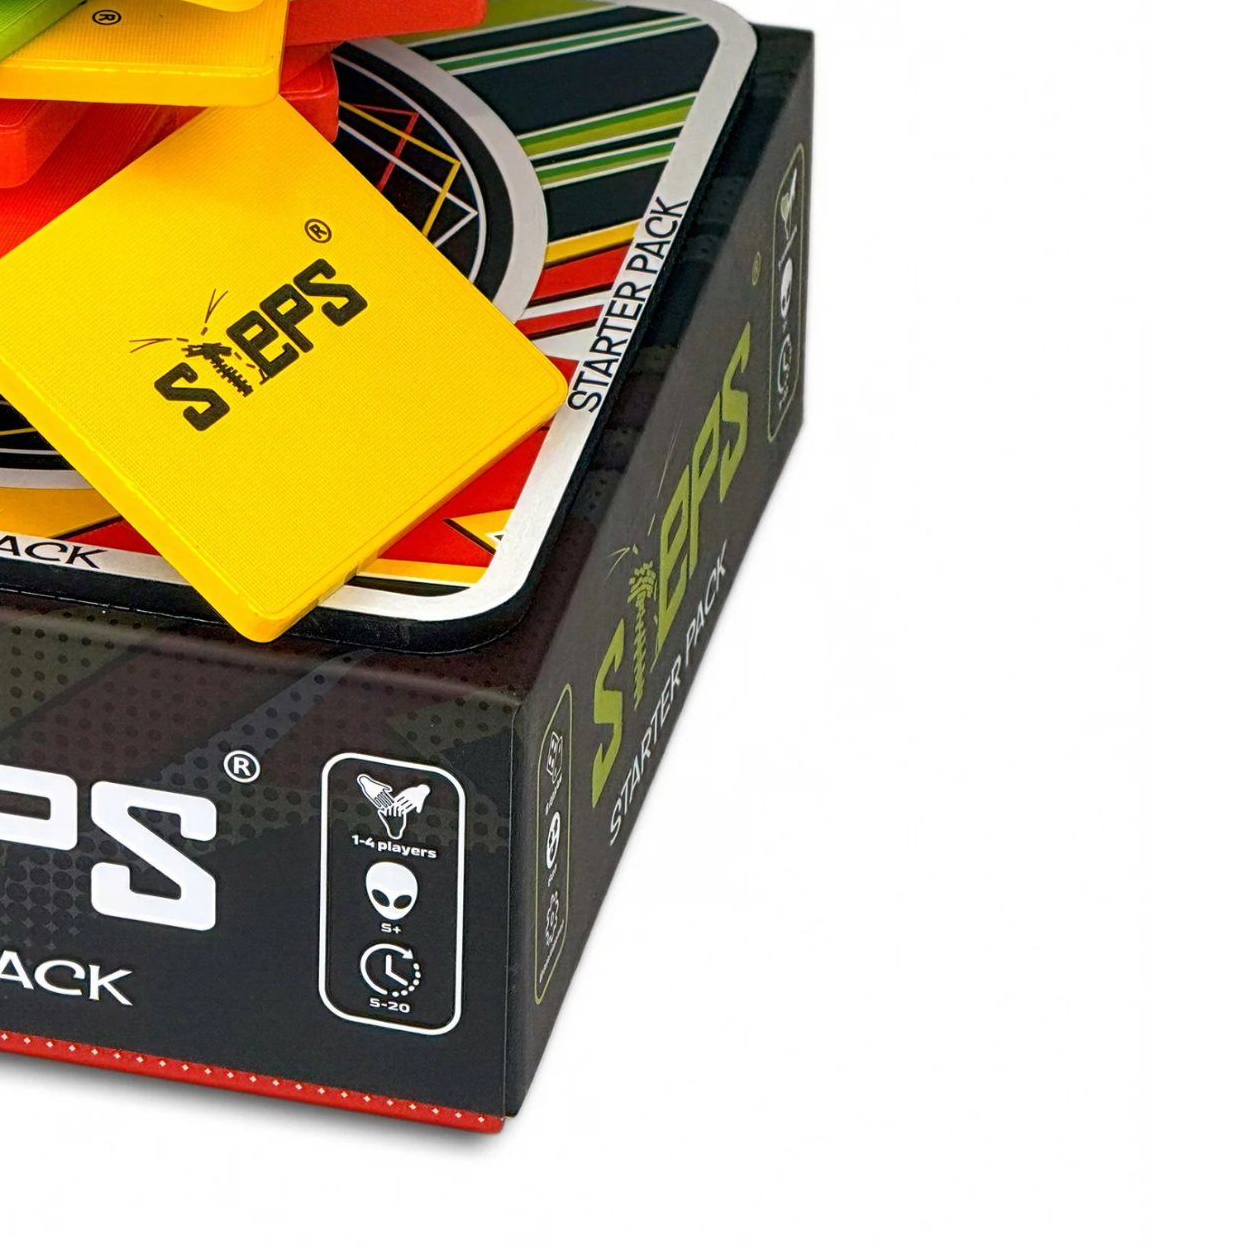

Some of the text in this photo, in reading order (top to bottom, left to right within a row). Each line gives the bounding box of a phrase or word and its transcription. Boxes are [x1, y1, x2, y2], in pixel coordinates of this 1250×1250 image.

[566, 196, 689, 414] STARTER PACK
[609, 539, 728, 846] STARTER PACK
[351, 834, 438, 859] 1-4 players
